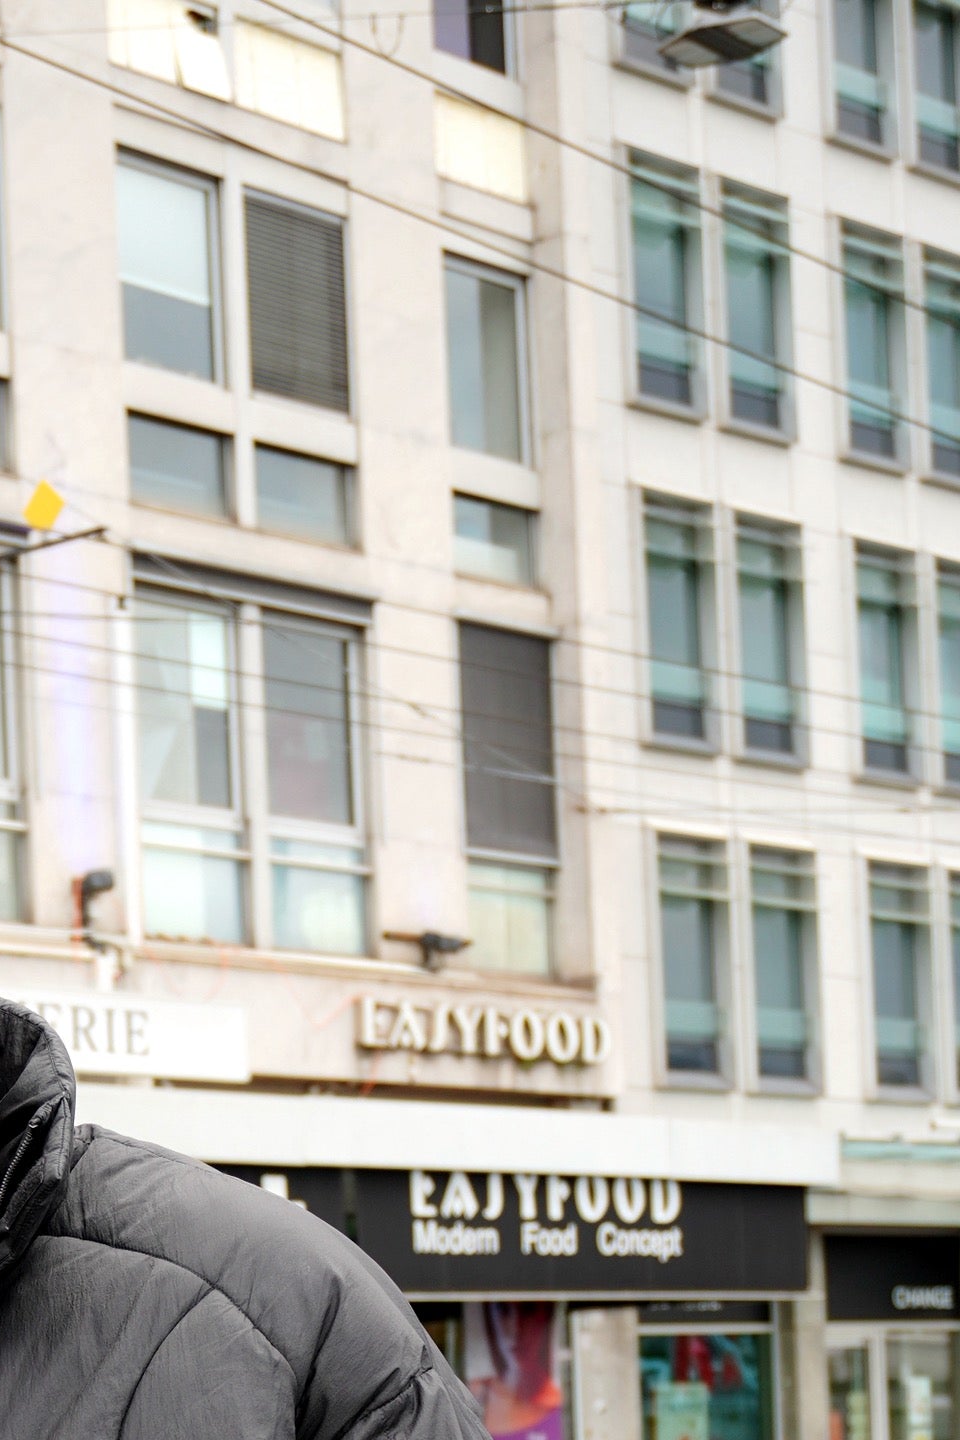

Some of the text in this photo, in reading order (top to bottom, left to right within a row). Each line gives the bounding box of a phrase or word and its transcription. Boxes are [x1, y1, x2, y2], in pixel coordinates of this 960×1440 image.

[411, 1219, 684, 1264] Modern Food Concept
